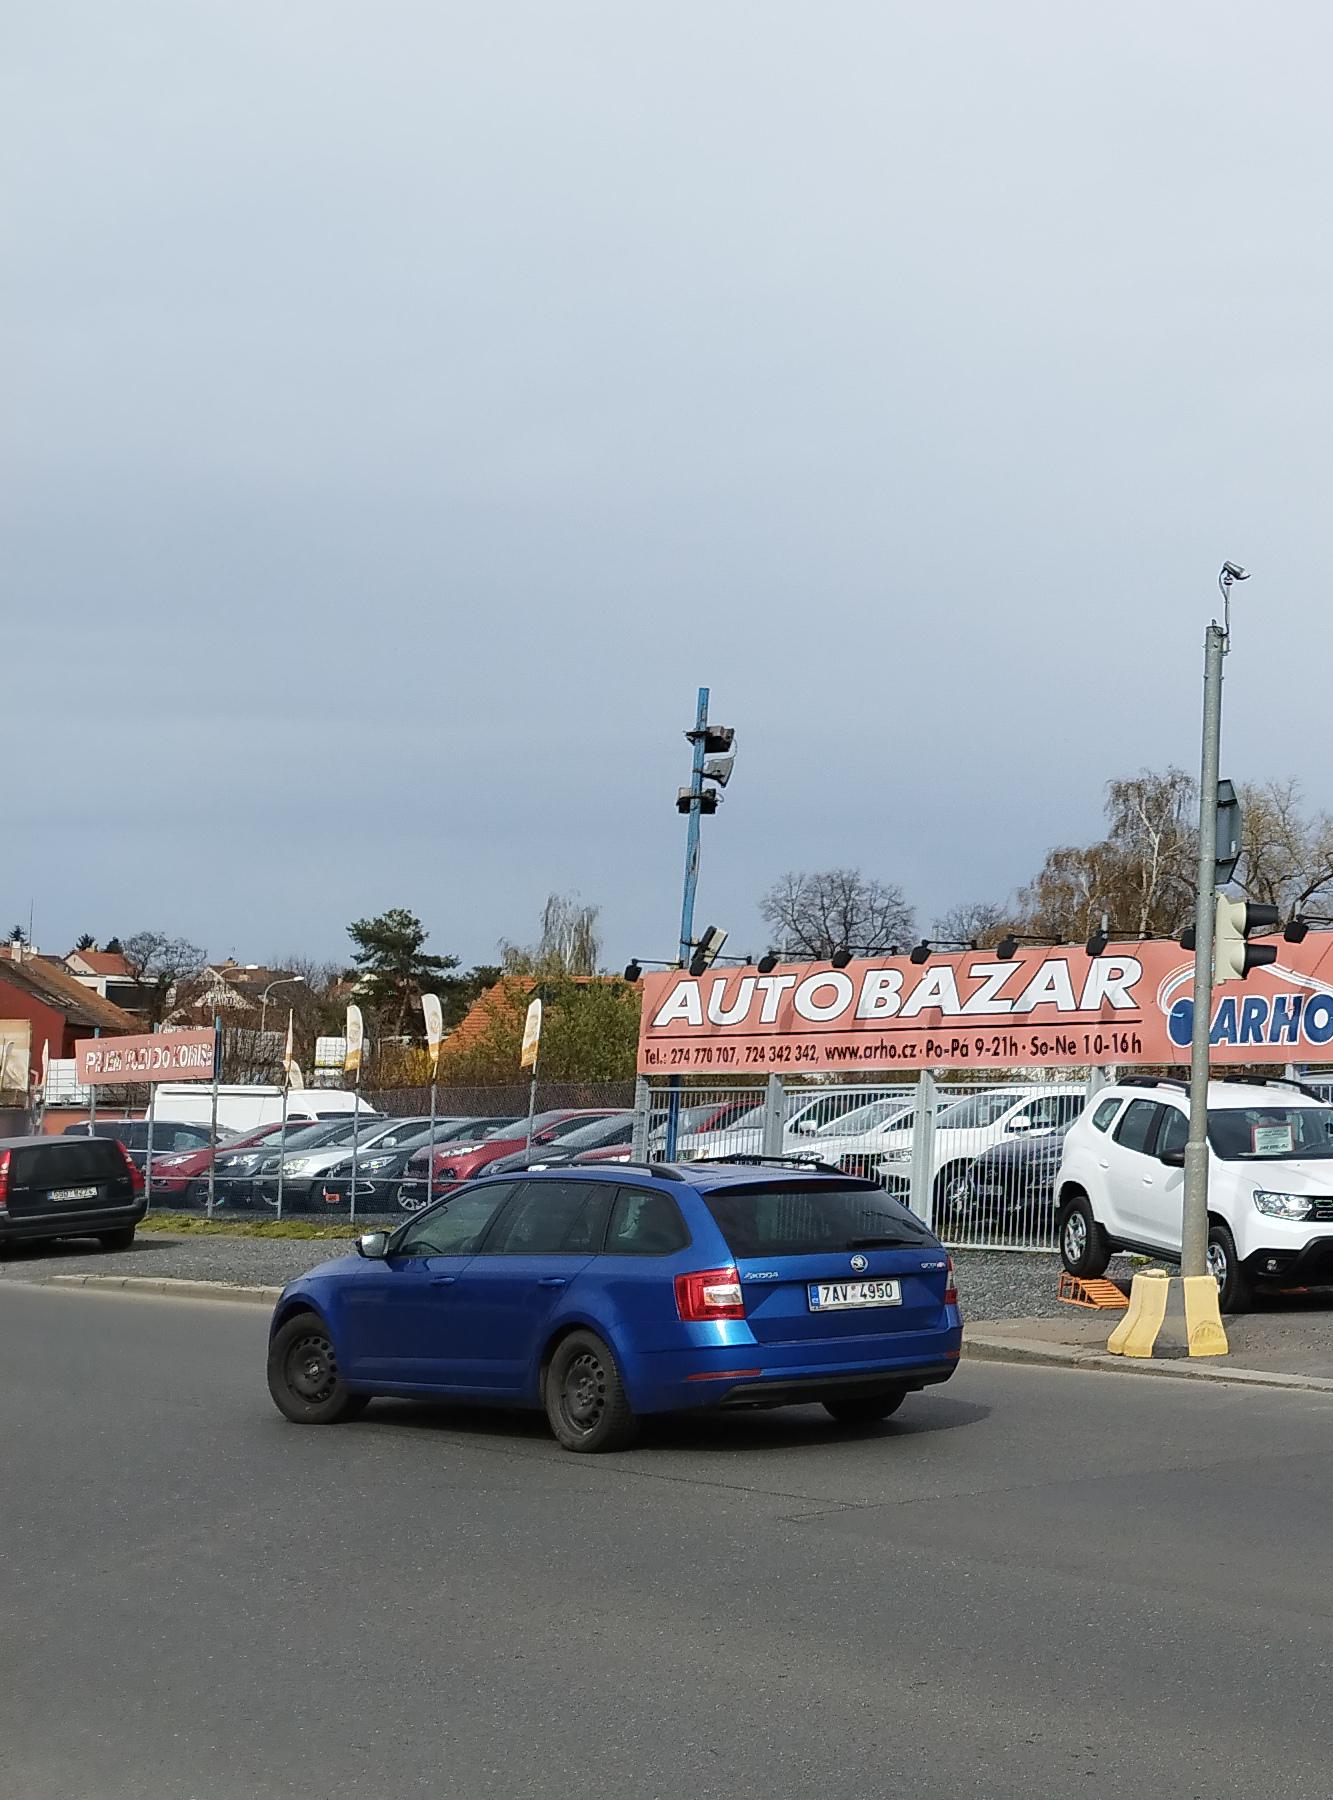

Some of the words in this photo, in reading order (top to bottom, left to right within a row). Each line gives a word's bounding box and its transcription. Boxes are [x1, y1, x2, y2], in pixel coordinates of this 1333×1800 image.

[651, 955, 1143, 1027] AUTOBAZAR
[645, 1048, 667, 1065] Tel.:
[671, 1048, 690, 1065] 274
[694, 1048, 713, 1064] 770
[716, 1046, 740, 1065] 707,
[745, 1046, 766, 1063] 724
[769, 1046, 791, 1063] 342
[795, 1045, 819, 1064] 342,
[825, 1038, 917, 1061] www.arho.cz
[926, 1036, 969, 1058] Po-Pá
[975, 1035, 1018, 1057] 9-21h
[1030, 1035, 1077, 1056] So-Ne
[822, 1286, 848, 1303] 7AV
[860, 1282, 893, 1300] 4950
